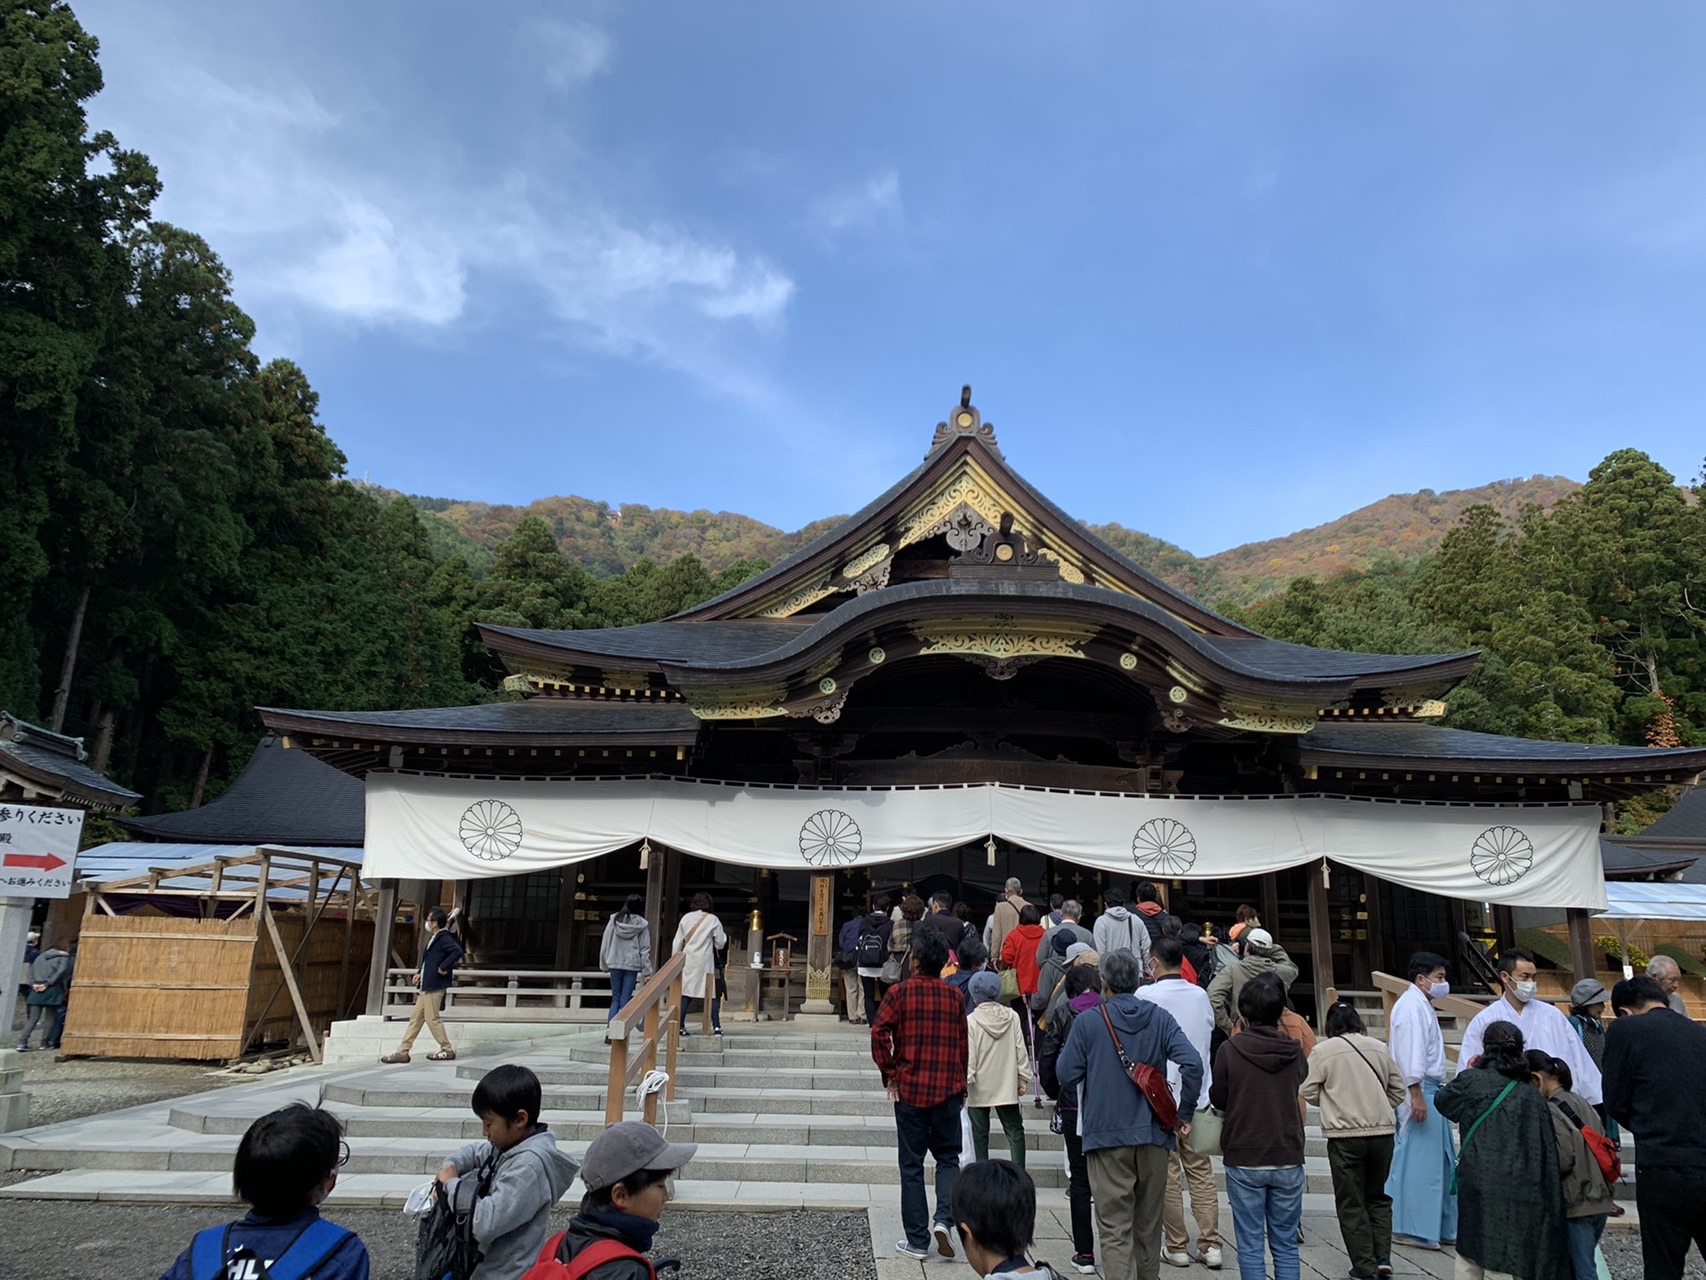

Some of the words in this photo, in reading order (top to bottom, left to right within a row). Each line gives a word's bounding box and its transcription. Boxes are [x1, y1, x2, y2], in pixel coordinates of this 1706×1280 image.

[0, 807, 81, 825] 参りください
